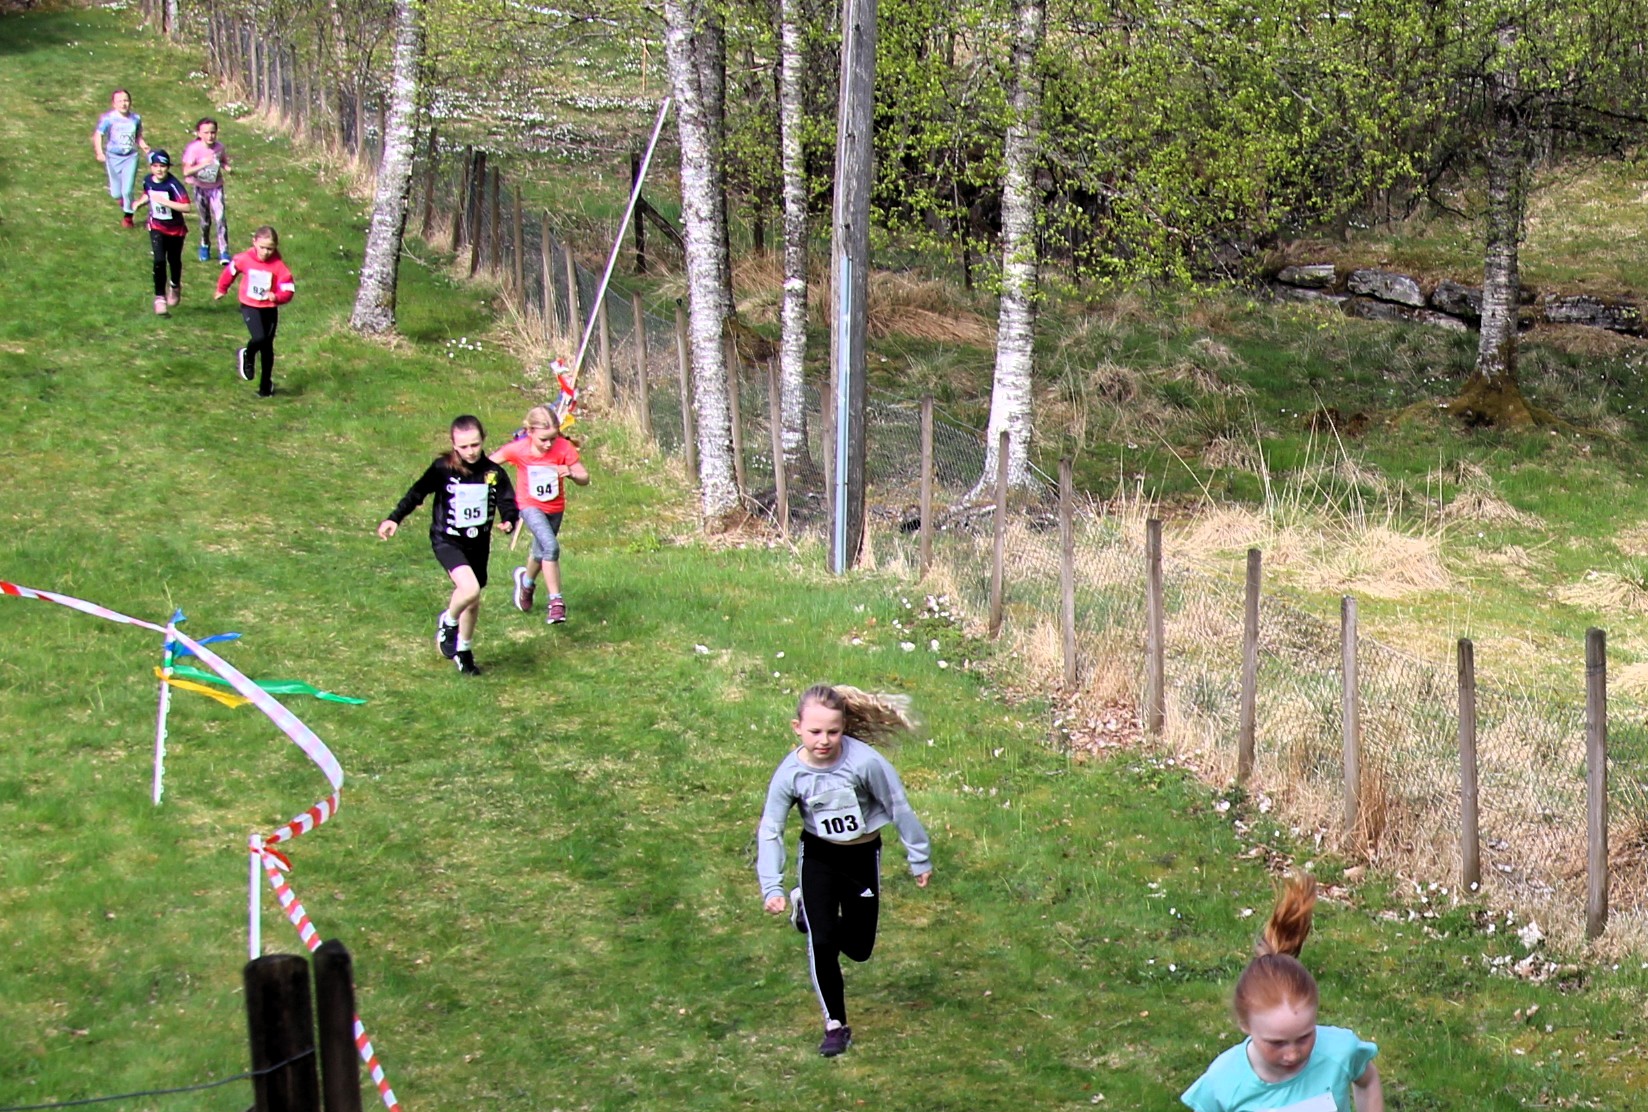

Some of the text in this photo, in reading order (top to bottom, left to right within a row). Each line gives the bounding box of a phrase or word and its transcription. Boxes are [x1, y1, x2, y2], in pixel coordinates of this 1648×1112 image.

[536, 484, 552, 497] 94
[464, 507, 481, 520] 95
[821, 814, 859, 835] 103
